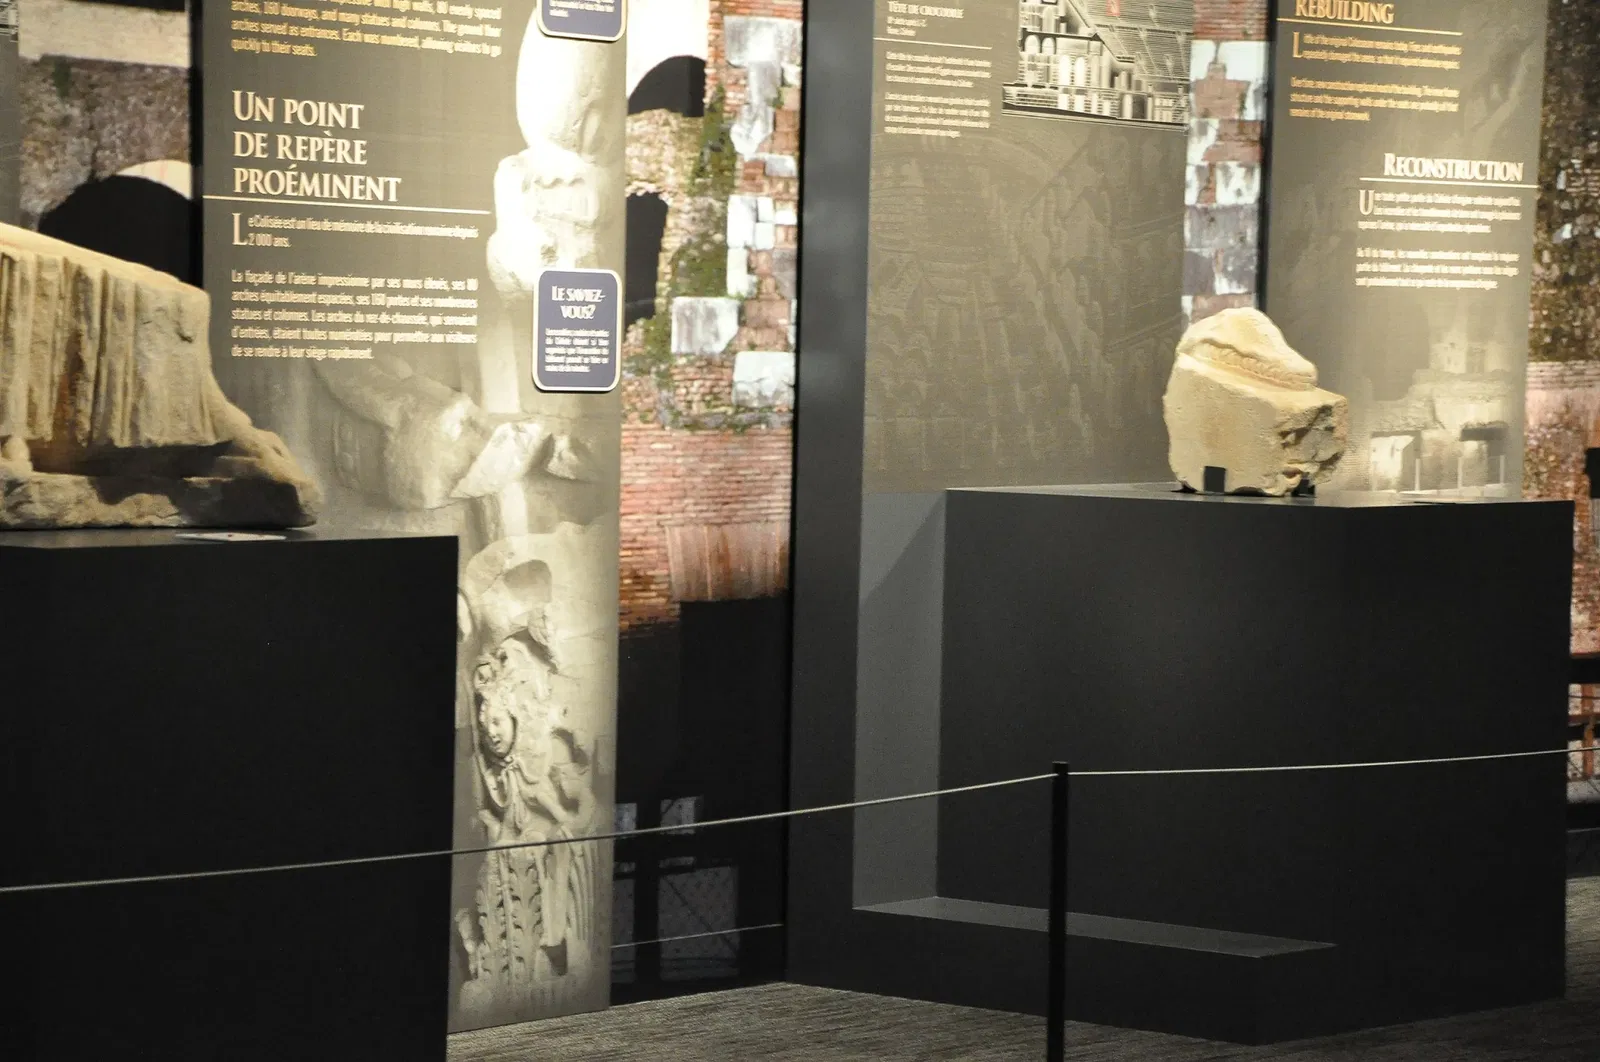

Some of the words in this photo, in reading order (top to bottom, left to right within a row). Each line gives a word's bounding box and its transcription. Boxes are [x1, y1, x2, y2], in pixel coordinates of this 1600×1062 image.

[321, 8, 338, 20] and
[1295, 0, 1395, 24] REBUILDING
[232, 90, 275, 123] UN
[283, 98, 365, 129] POINT
[233, 131, 269, 159] DE
[276, 131, 367, 165] REPÈRE
[1383, 152, 1524, 182] RECONSTRUCTION
[233, 163, 402, 202] PROÉMINENT
[231, 269, 243, 282] La
[245, 270, 274, 286] façade
[275, 272, 287, 283] de
[552, 286, 565, 301] LE
